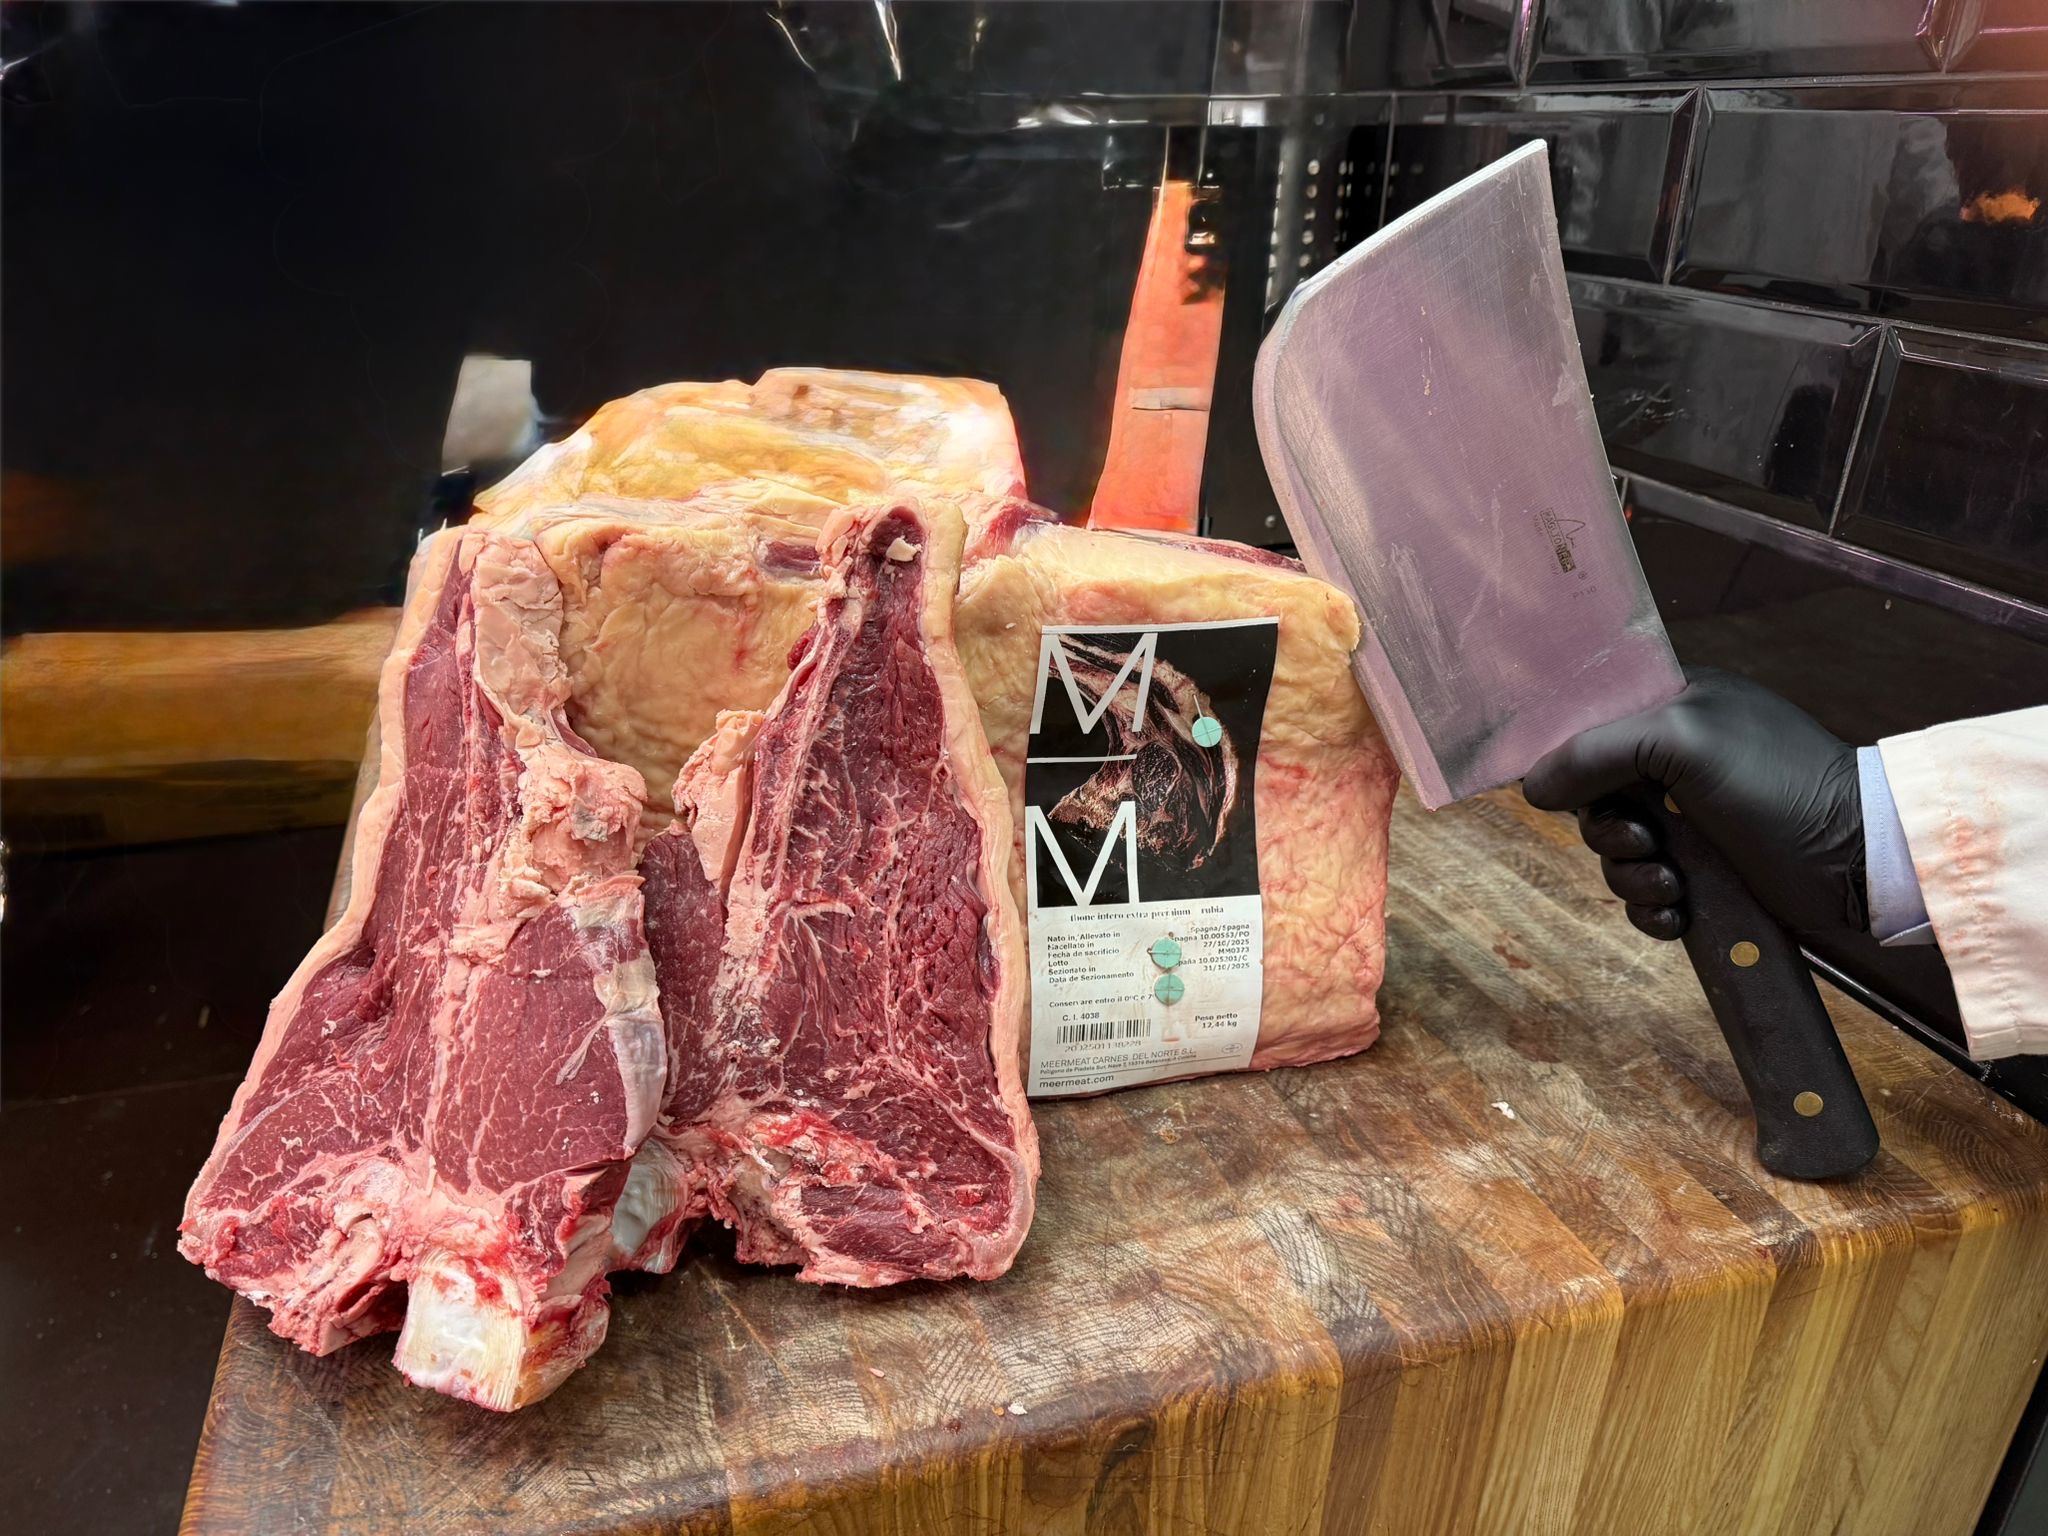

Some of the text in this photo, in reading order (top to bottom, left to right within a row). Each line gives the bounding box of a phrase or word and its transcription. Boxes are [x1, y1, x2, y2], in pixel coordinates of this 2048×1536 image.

[1029, 633, 1158, 735] M
[1025, 800, 1140, 908] M
[1097, 912, 1124, 920] intero
[1201, 905, 1224, 914] rubia
[1047, 935, 1066, 943] Nato
[1203, 939, 1250, 948] 27/10/2025
[1047, 951, 1071, 959] Fecha
[1084, 948, 1120, 956] sacrificio
[1048, 959, 1069, 968] Lotto
[1048, 967, 1087, 976] Sezionato
[1049, 976, 1067, 984] Data
[1080, 971, 1135, 981] Sezionamento
[1080, 1012, 1100, 1020] 4038
[1040, 1057, 1091, 1068] MEERMEAT
[1092, 1054, 1129, 1065] CARNES
[1132, 1052, 1149, 1060] DEL
[1151, 1049, 1180, 1059] NORTE
[1039, 1075, 1114, 1088] meermeat.com
